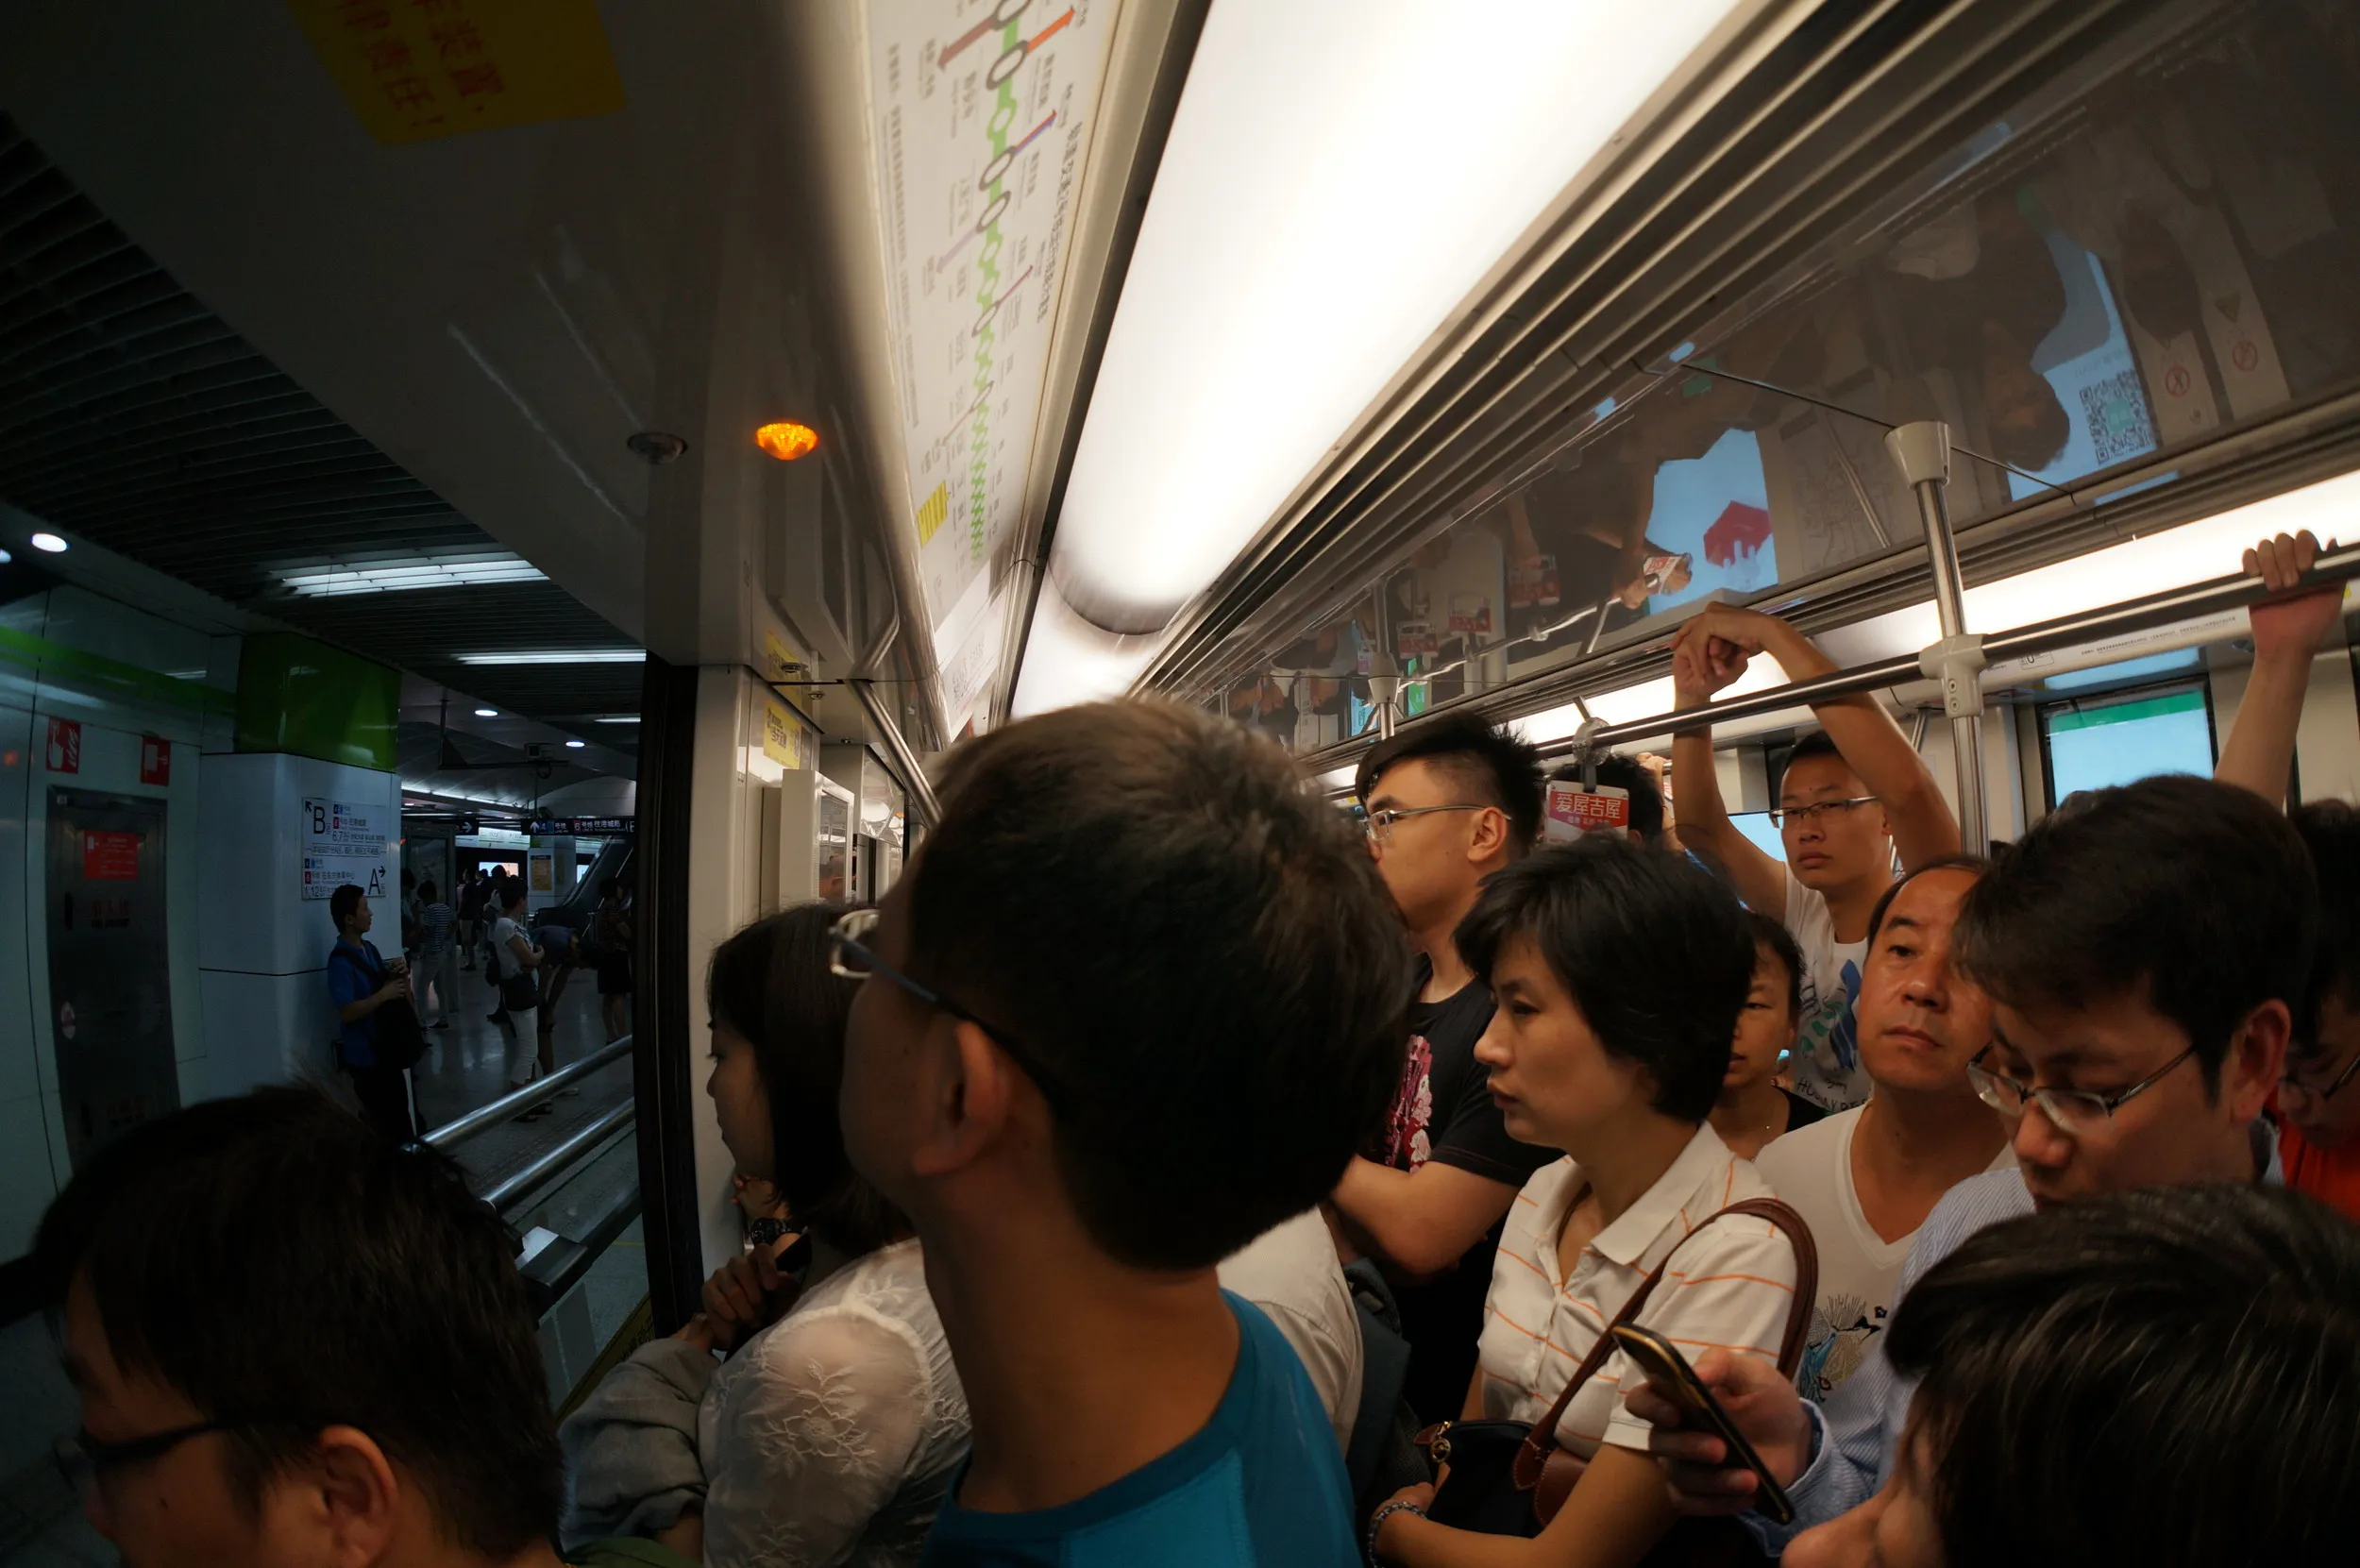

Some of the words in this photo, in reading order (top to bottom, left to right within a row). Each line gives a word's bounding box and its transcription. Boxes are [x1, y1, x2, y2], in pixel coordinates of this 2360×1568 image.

[1556, 793, 1622, 819] 爱屋吉屋
[313, 805, 326, 835] B
[368, 868, 380, 895] A
